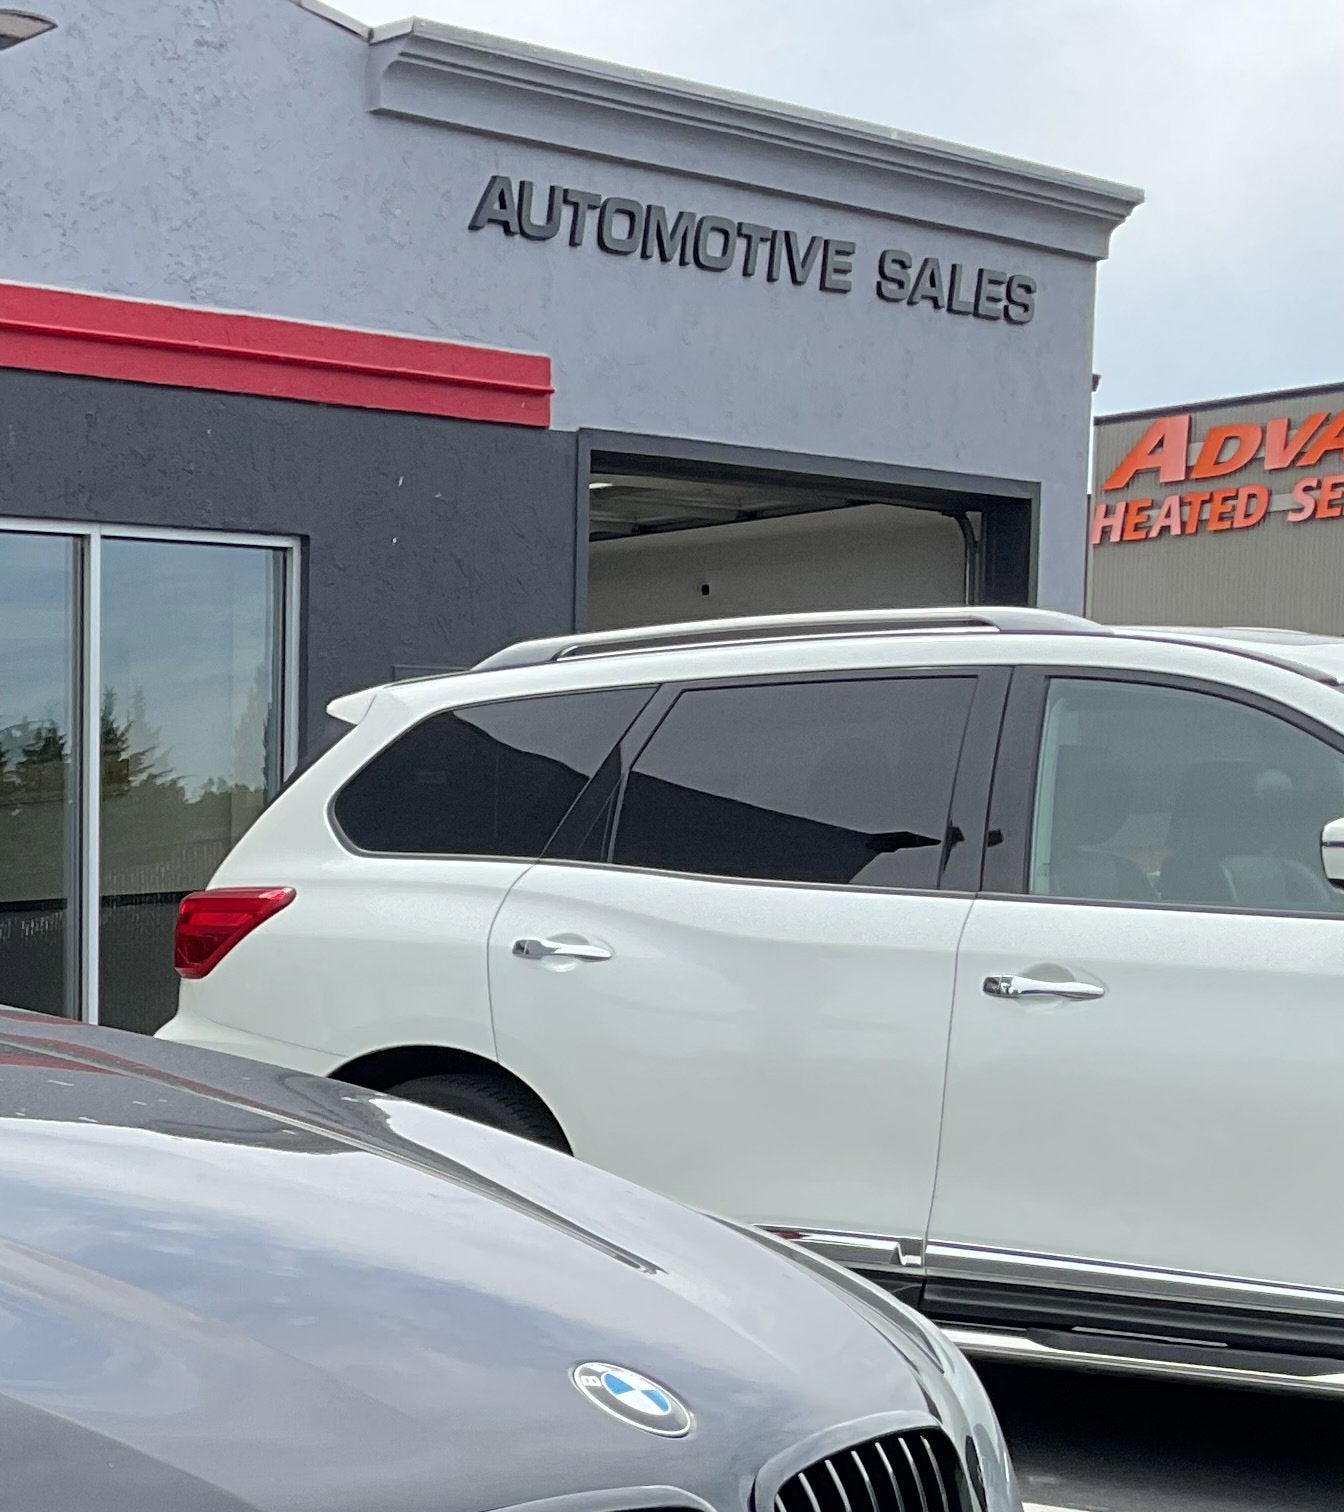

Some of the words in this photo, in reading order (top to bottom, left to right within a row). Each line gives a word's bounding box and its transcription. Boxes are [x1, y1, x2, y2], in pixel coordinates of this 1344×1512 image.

[468, 175, 856, 293] AUTOMOTIVE
[875, 249, 1037, 324] SALES
[1090, 484, 1270, 545] HEATED
